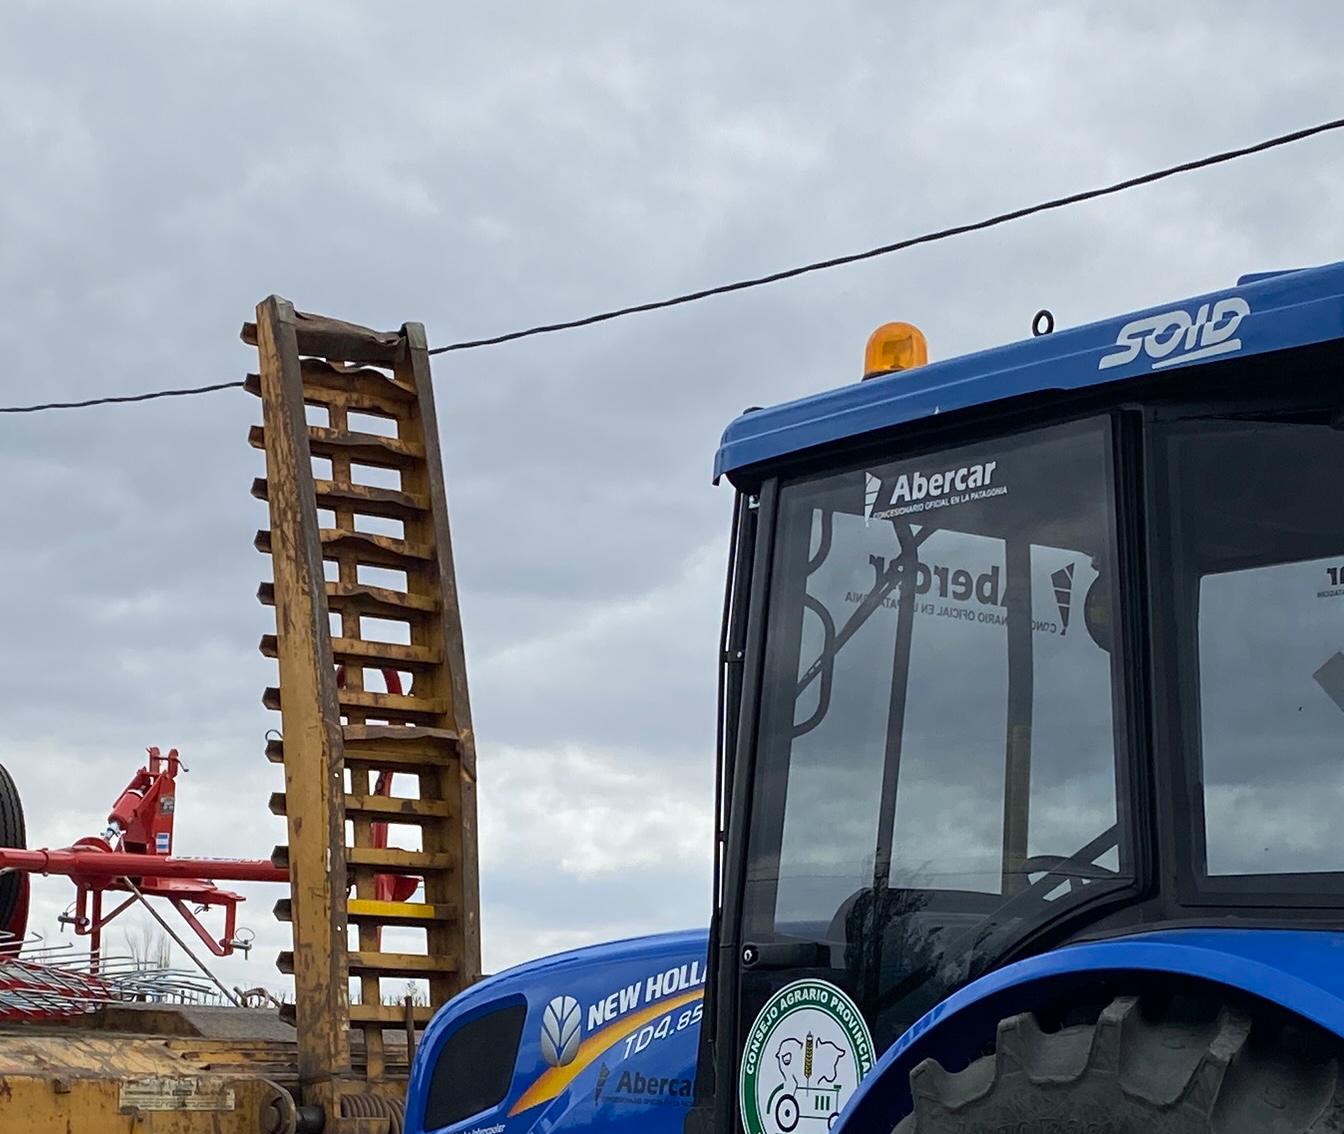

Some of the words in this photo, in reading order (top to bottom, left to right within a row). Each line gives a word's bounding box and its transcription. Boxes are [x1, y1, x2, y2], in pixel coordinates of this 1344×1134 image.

[889, 461, 996, 505] Abercar
[587, 981, 642, 1031] NEW
[623, 1003, 704, 1060] TD4.85
[746, 1006, 779, 1075] CONSEJO
[780, 988, 829, 1011] AGRARIO
